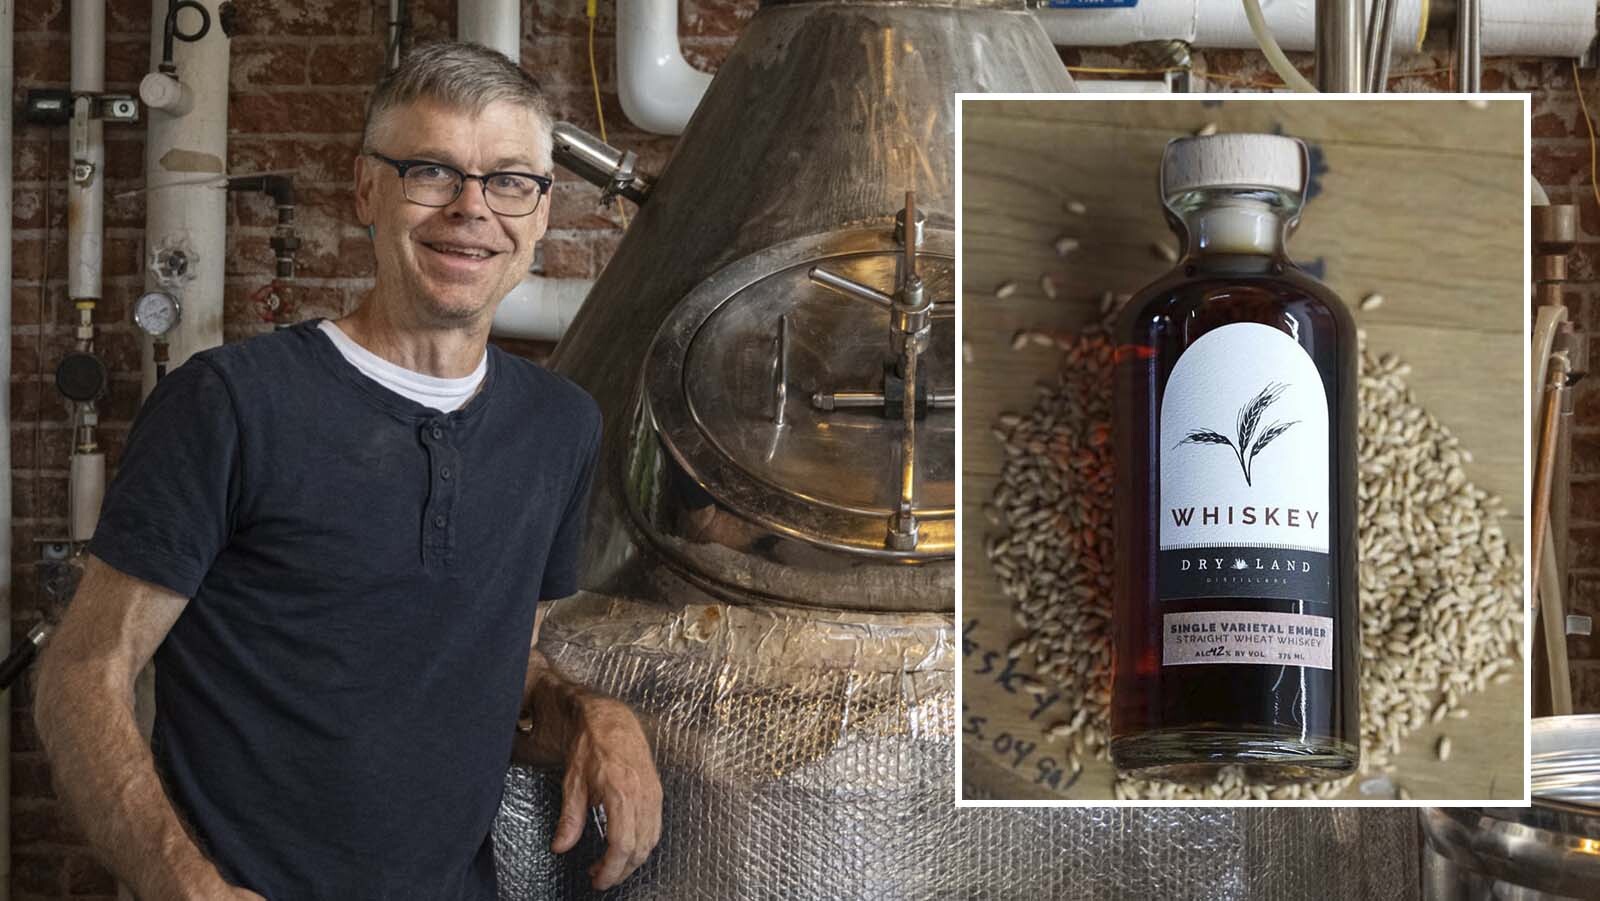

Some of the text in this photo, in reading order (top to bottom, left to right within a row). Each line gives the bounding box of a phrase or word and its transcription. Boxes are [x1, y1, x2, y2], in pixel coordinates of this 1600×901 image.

[1171, 506, 1320, 529] WHISKEY
[1181, 558, 1312, 573] DRY LAND
[1170, 623, 1327, 638] SINGLE VARIETAL EMMER
[1176, 634, 1322, 648] STRAIGHT WHEAT WHISKEY
